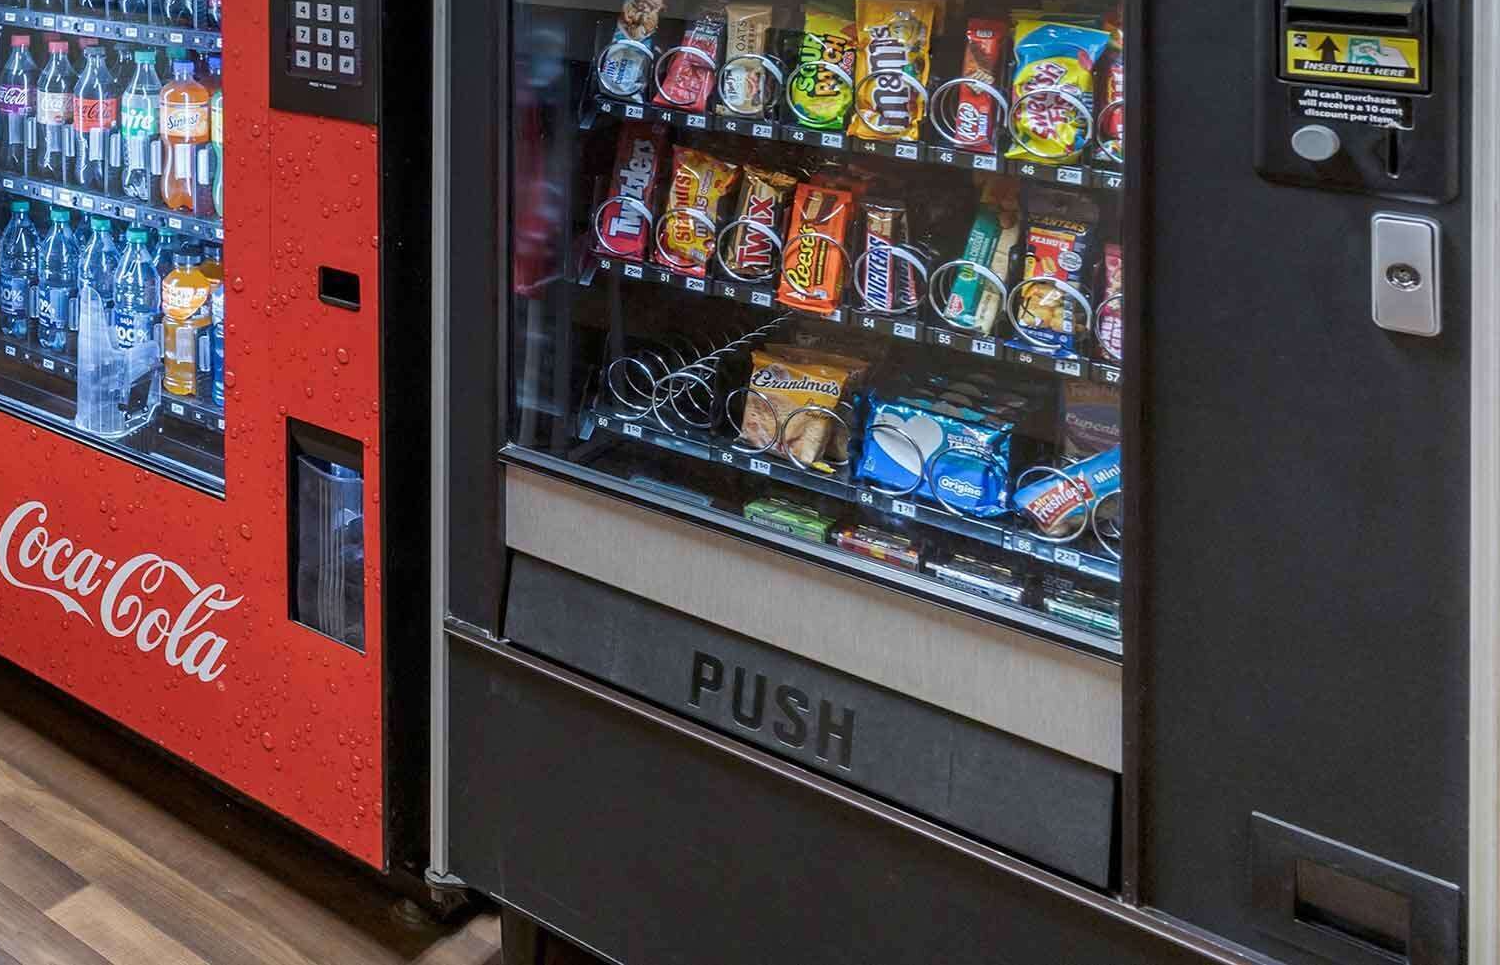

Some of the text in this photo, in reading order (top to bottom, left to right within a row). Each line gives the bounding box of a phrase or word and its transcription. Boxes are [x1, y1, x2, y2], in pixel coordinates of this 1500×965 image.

[300, 5, 350, 20] 4 5 6
[300, 30, 350, 45] 7 8 9
[736, 20, 748, 52] OATS
[322, 57, 328, 66] 0
[1303, 61, 1406, 77] INSERT BILL HERE
[1304, 89, 1397, 106] All cash purchases
[1299, 98, 1317, 107] will
[1319, 101, 1355, 111] receive
[1366, 104, 1377, 112] 10
[1380, 106, 1403, 116] cent
[662, 112, 671, 121] 41
[1305, 108, 1348, 120] discount
[1350, 113, 1367, 123] per
[725, 122, 736, 131] 42
[793, 132, 804, 141] 43
[864, 142, 876, 151] 44
[940, 153, 952, 163] 45
[1021, 165, 1035, 174] 46
[1107, 178, 1121, 187] 47
[600, 260, 610, 269] 50
[660, 273, 670, 283] 51
[867, 237, 889, 309] NICKERS
[724, 288, 735, 297] 52
[863, 318, 875, 328] 54
[939, 334, 950, 344] 55
[1019, 354, 1032, 364] 56
[1106, 372, 1120, 382] 57
[751, 370, 841, 397] Grandma's
[599, 418, 608, 427] 60
[722, 452, 733, 463] 62
[941, 478, 981, 497] Origina
[861, 493, 874, 504] 64
[687, 650, 855, 771] PUSH
